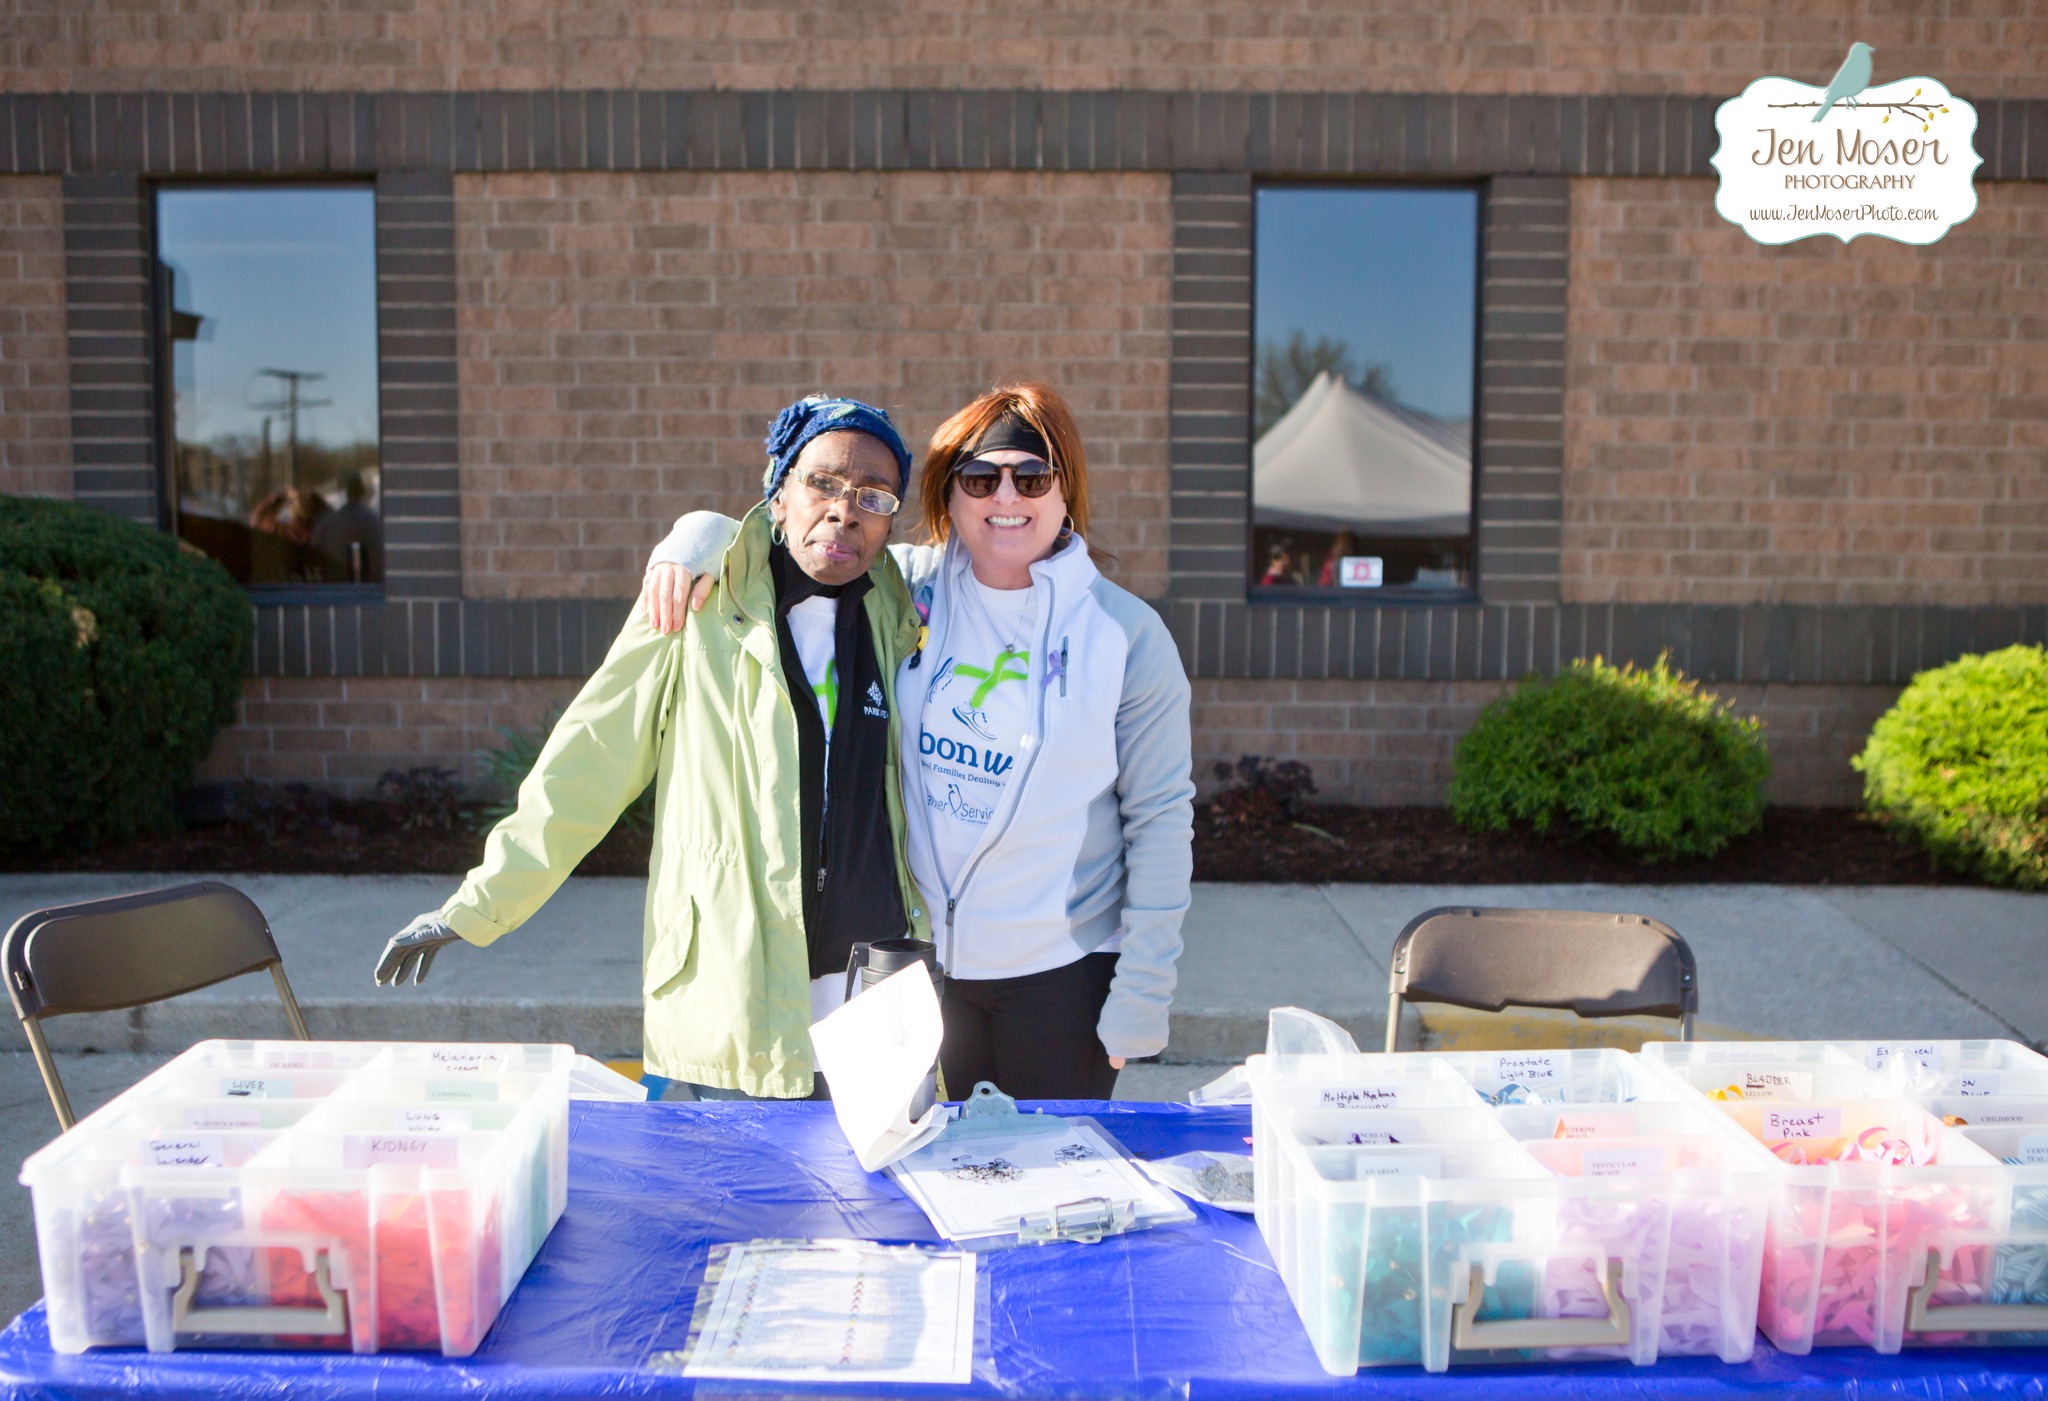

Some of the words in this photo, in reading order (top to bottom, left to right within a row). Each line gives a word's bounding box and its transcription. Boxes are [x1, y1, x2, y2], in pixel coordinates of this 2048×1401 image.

[933, 764, 966, 781] Families
[967, 773, 1001, 788] Dealing
[1500, 1057, 1551, 1068] Prostate
[1500, 1070, 1524, 1081] Light
[1746, 1073, 1792, 1086] BLADDER
[233, 1079, 264, 1091] LIVER
[1324, 1091, 1361, 1104] Multiple
[1770, 1112, 1825, 1128] Breast
[1782, 1127, 1811, 1139] Pink
[371, 1139, 428, 1152] KIDNEY
[1591, 1161, 1637, 1170] TESTICULAR
